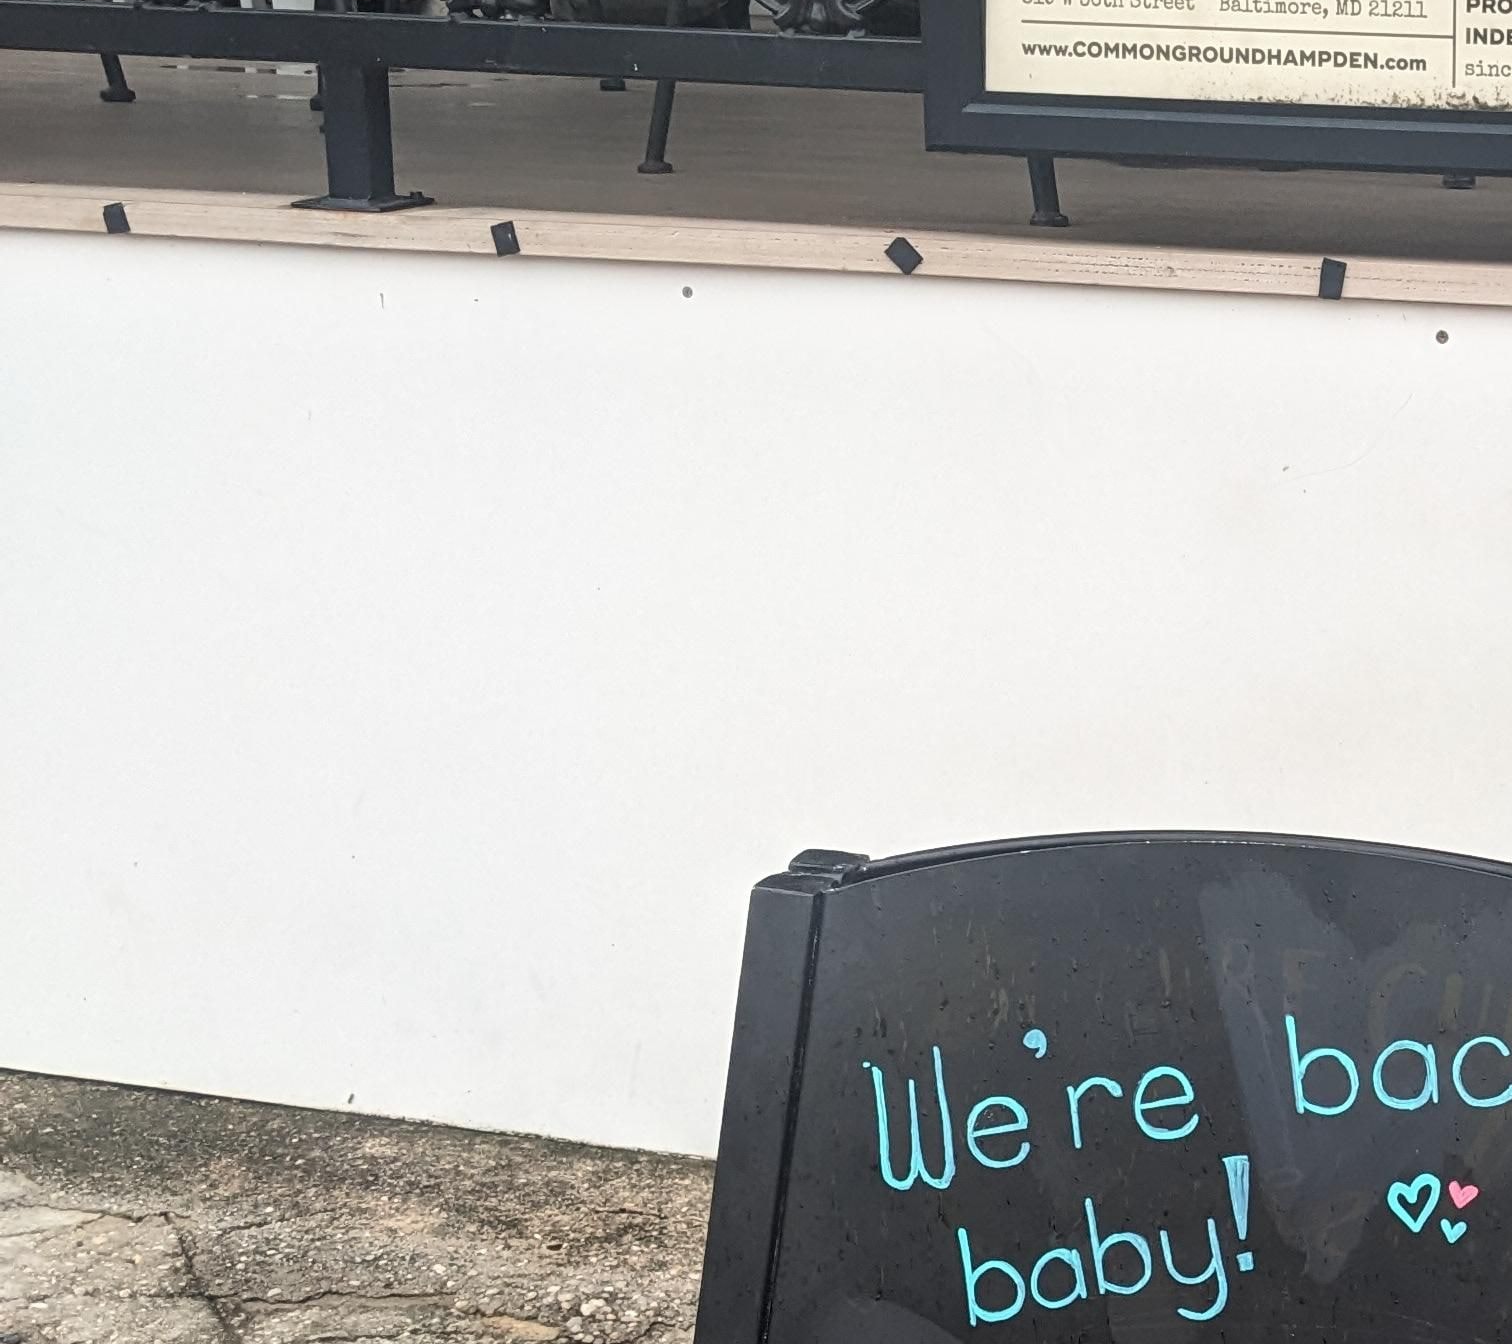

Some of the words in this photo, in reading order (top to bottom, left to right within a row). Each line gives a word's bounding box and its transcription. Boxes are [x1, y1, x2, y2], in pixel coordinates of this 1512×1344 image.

[1021, 40, 1428, 73] www.COMMONGROUNDHAMPDEN.com
[1336, 0, 1362, 17] MD
[1368, 0, 1428, 20] 21211
[861, 1028, 1200, 1192] We're
[957, 1153, 1255, 1328] baby!
